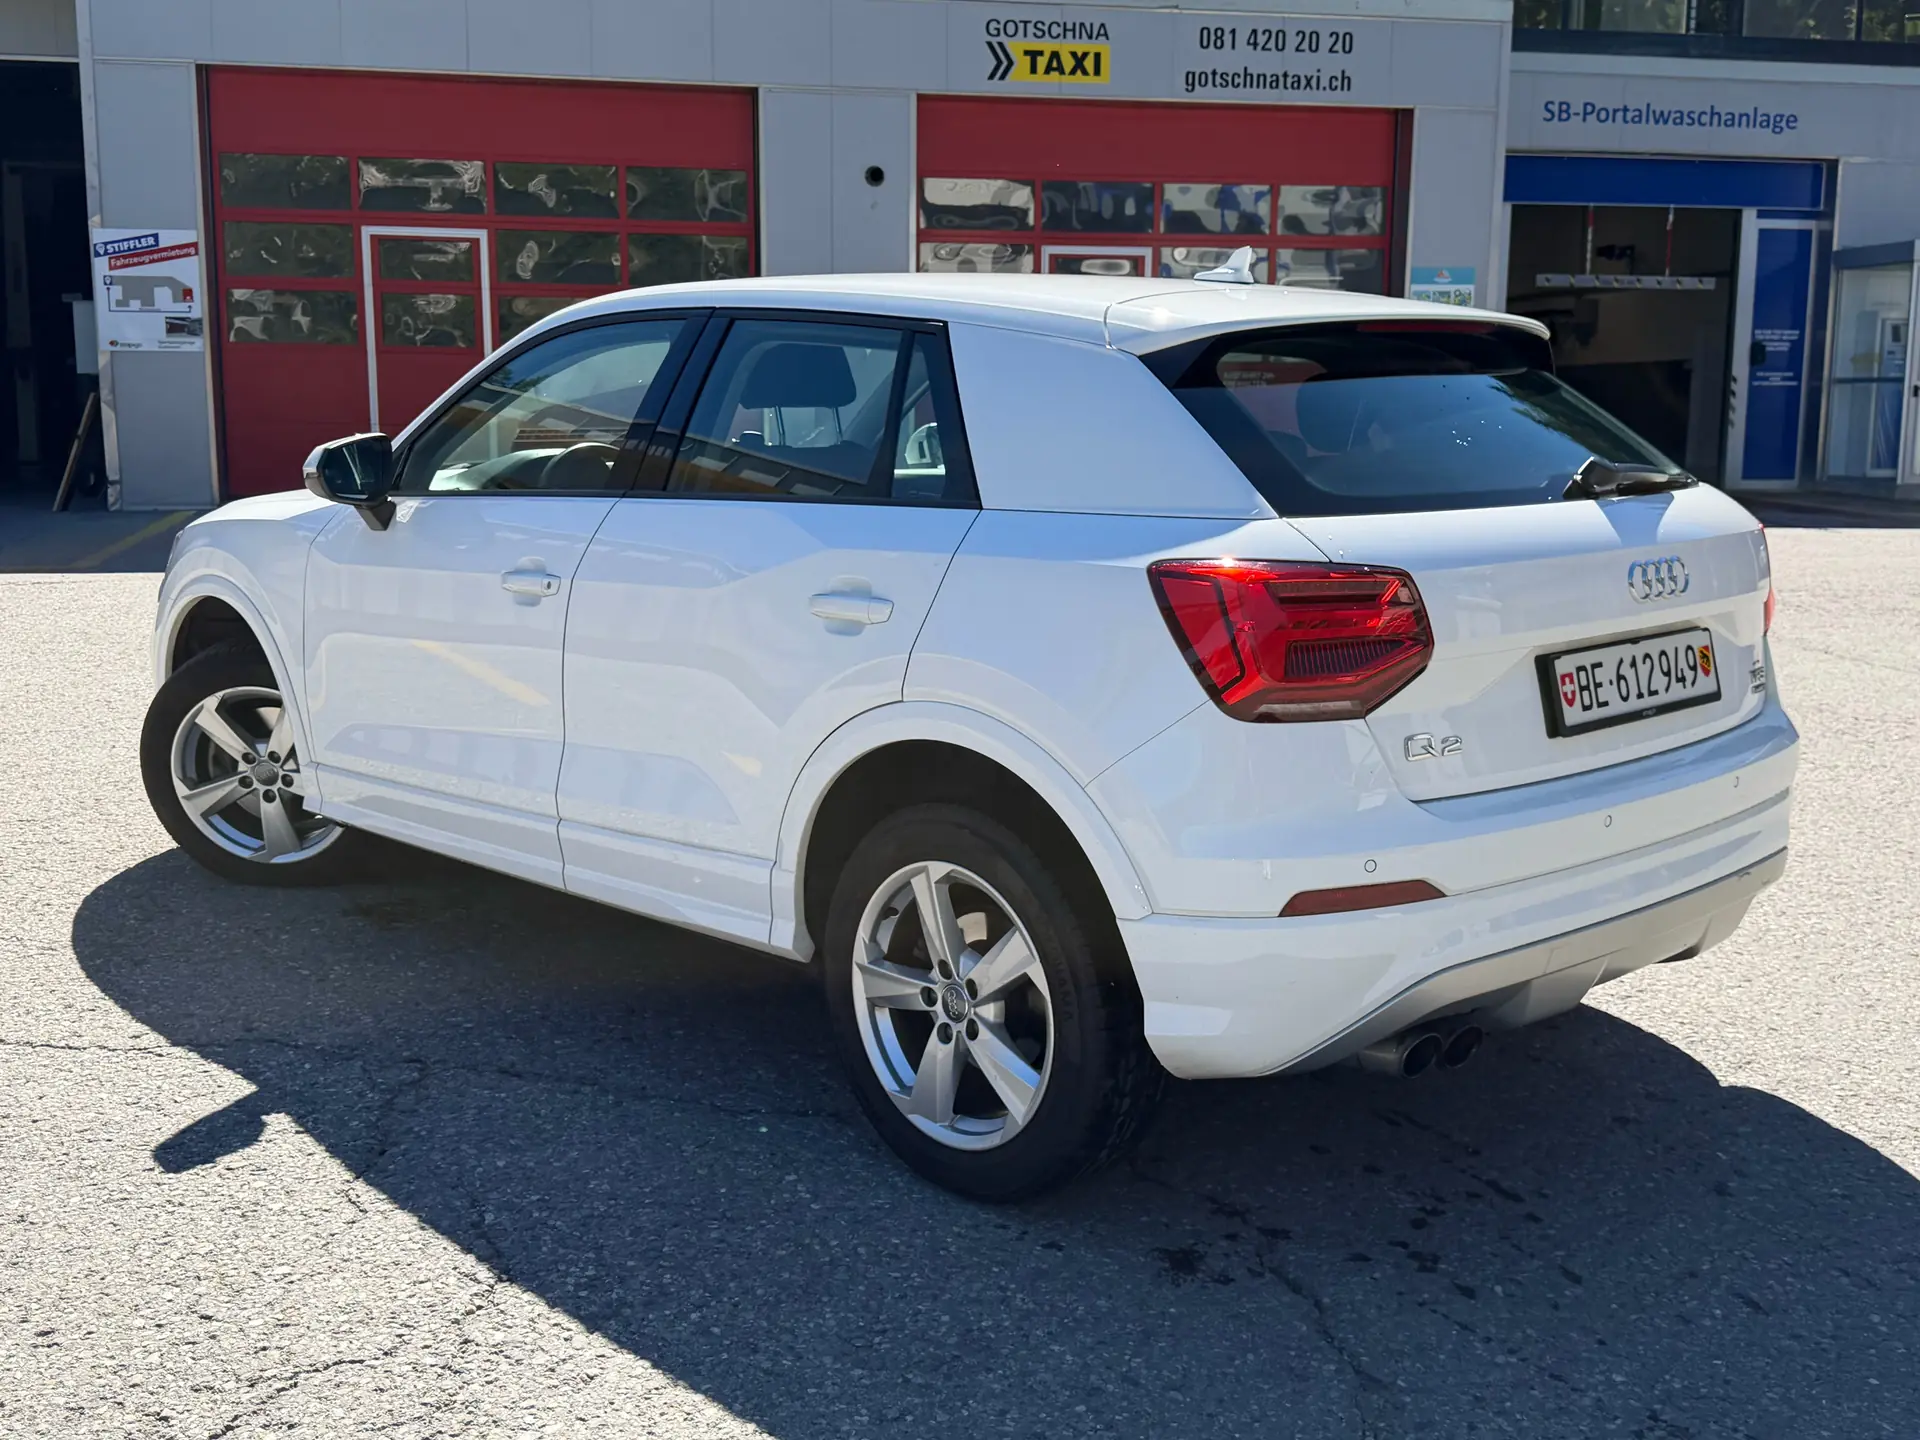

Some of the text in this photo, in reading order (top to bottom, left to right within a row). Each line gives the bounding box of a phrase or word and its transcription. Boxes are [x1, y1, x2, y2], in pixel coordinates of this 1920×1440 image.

[985, 18, 1110, 41] GOTSCHNA
[1199, 26, 1353, 54] 081 420 20 20
[1023, 49, 1102, 77] TAXI
[1184, 66, 1352, 93] gotschnataxi.ch
[1543, 100, 1799, 135] SB-Portalwaschanlage
[106, 236, 156, 254] STIFFLER
[110, 246, 196, 267] Fahrzeugvermietung
[1403, 732, 1464, 762] Q2
